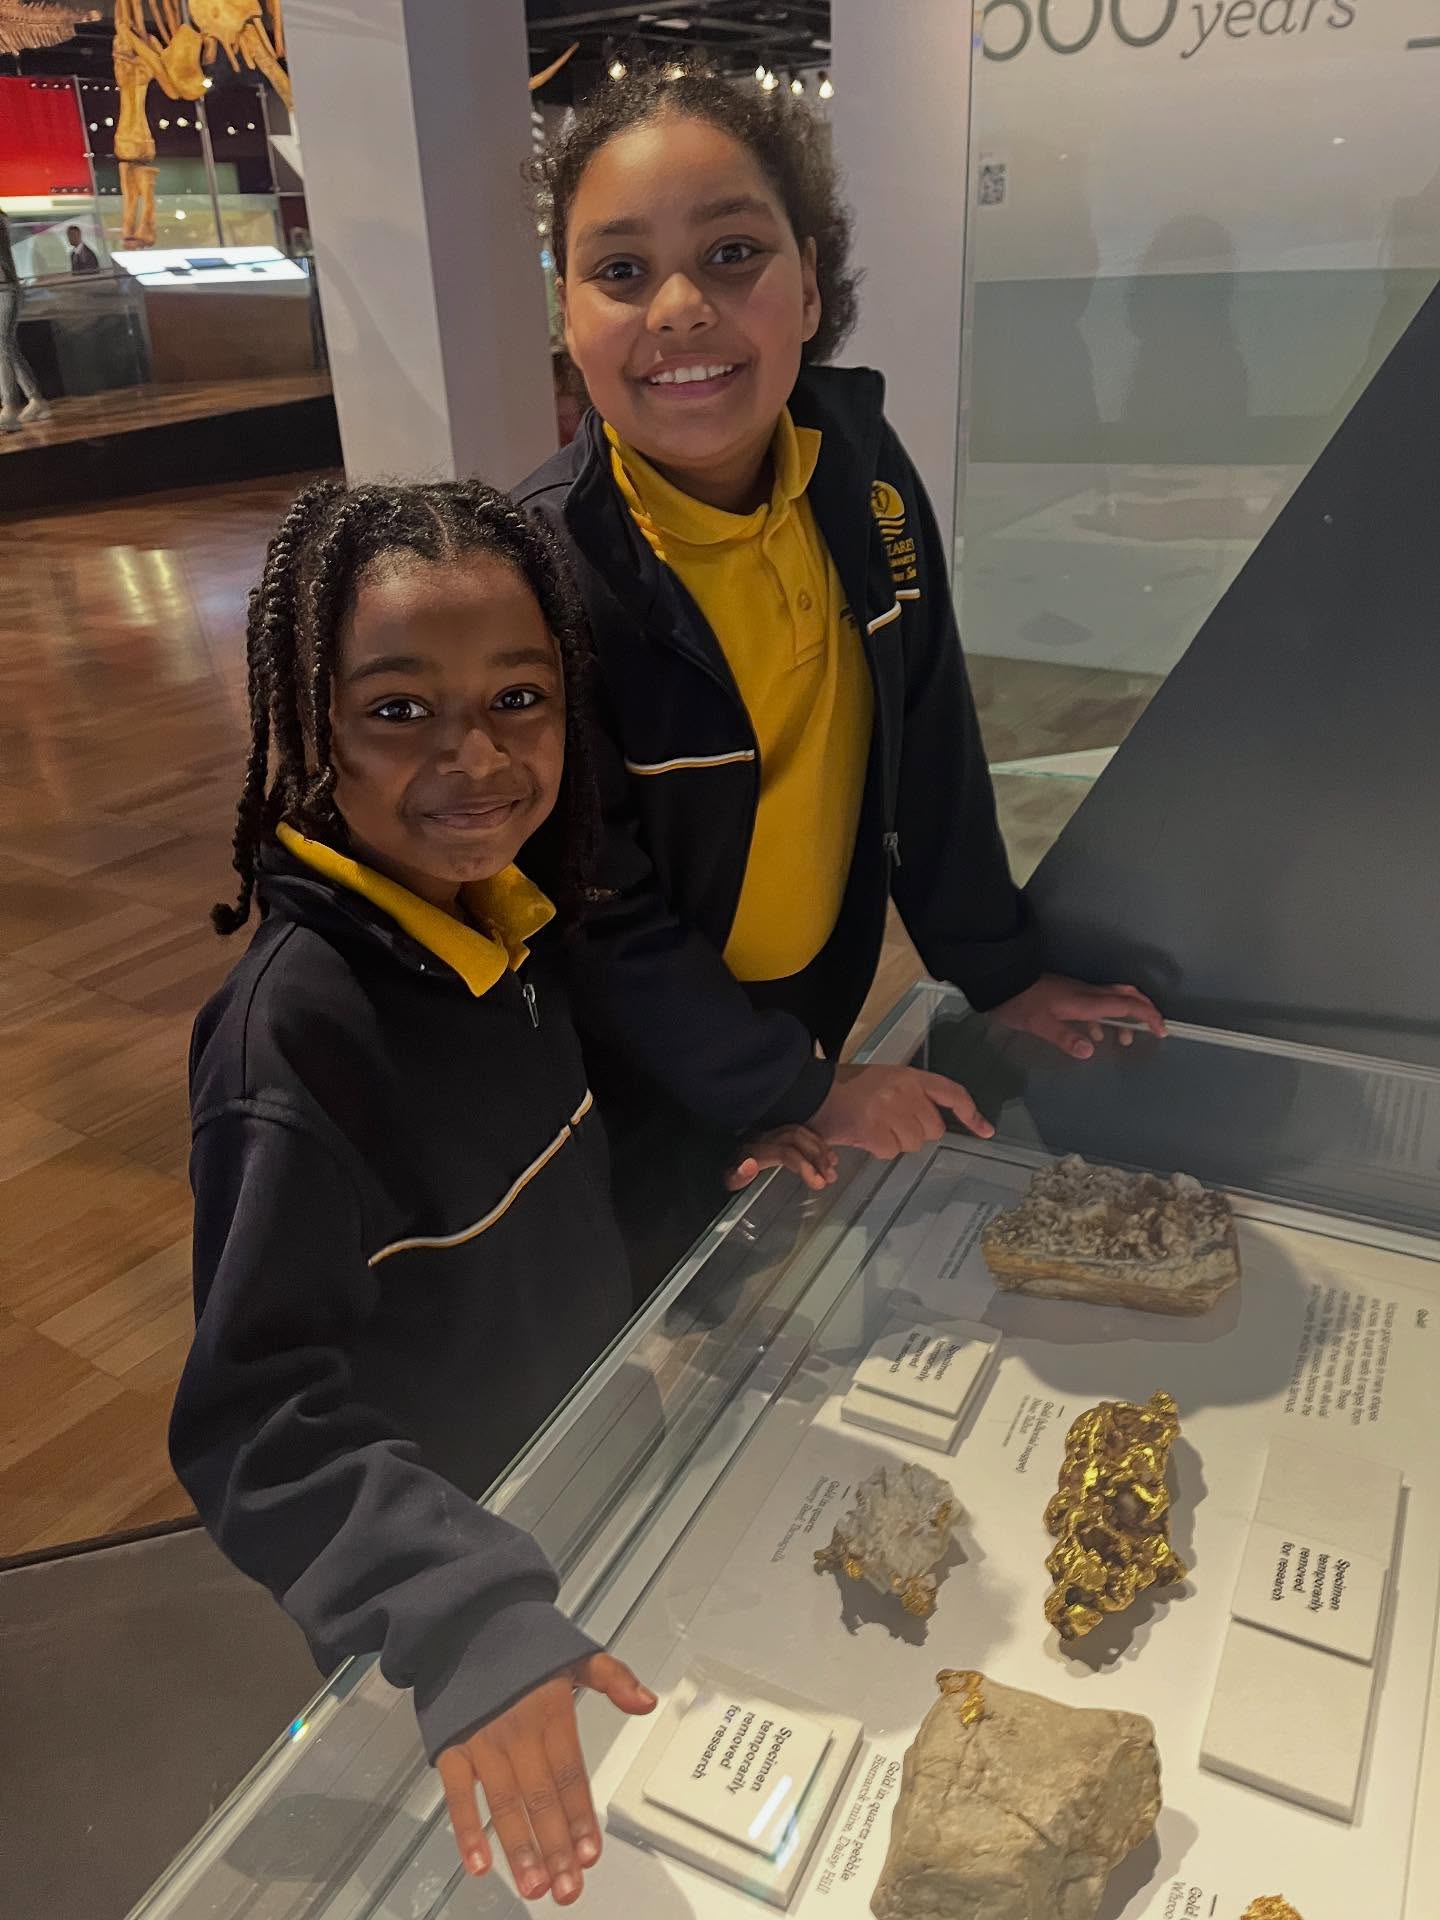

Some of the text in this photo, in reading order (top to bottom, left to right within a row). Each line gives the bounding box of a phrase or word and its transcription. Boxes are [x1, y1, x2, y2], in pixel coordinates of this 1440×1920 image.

[1180, 0, 1356, 58] years
[1272, 1542, 1295, 1601] for research
[1293, 1547, 1310, 1593] removed
[1306, 1554, 1330, 1612] temporarily
[1330, 1559, 1350, 1610] Specimen
[692, 1705, 741, 1780] for research
[720, 1712, 756, 1769] removed
[726, 1720, 774, 1794] temporarily
[751, 1727, 792, 1791] Specimen
[881, 1761, 900, 1788] Gold
[858, 1802, 880, 1840] quartz
[816, 1869, 836, 1894] Hill
[841, 1839, 864, 1880] pebble
[1186, 1887, 1202, 1917] Gold
